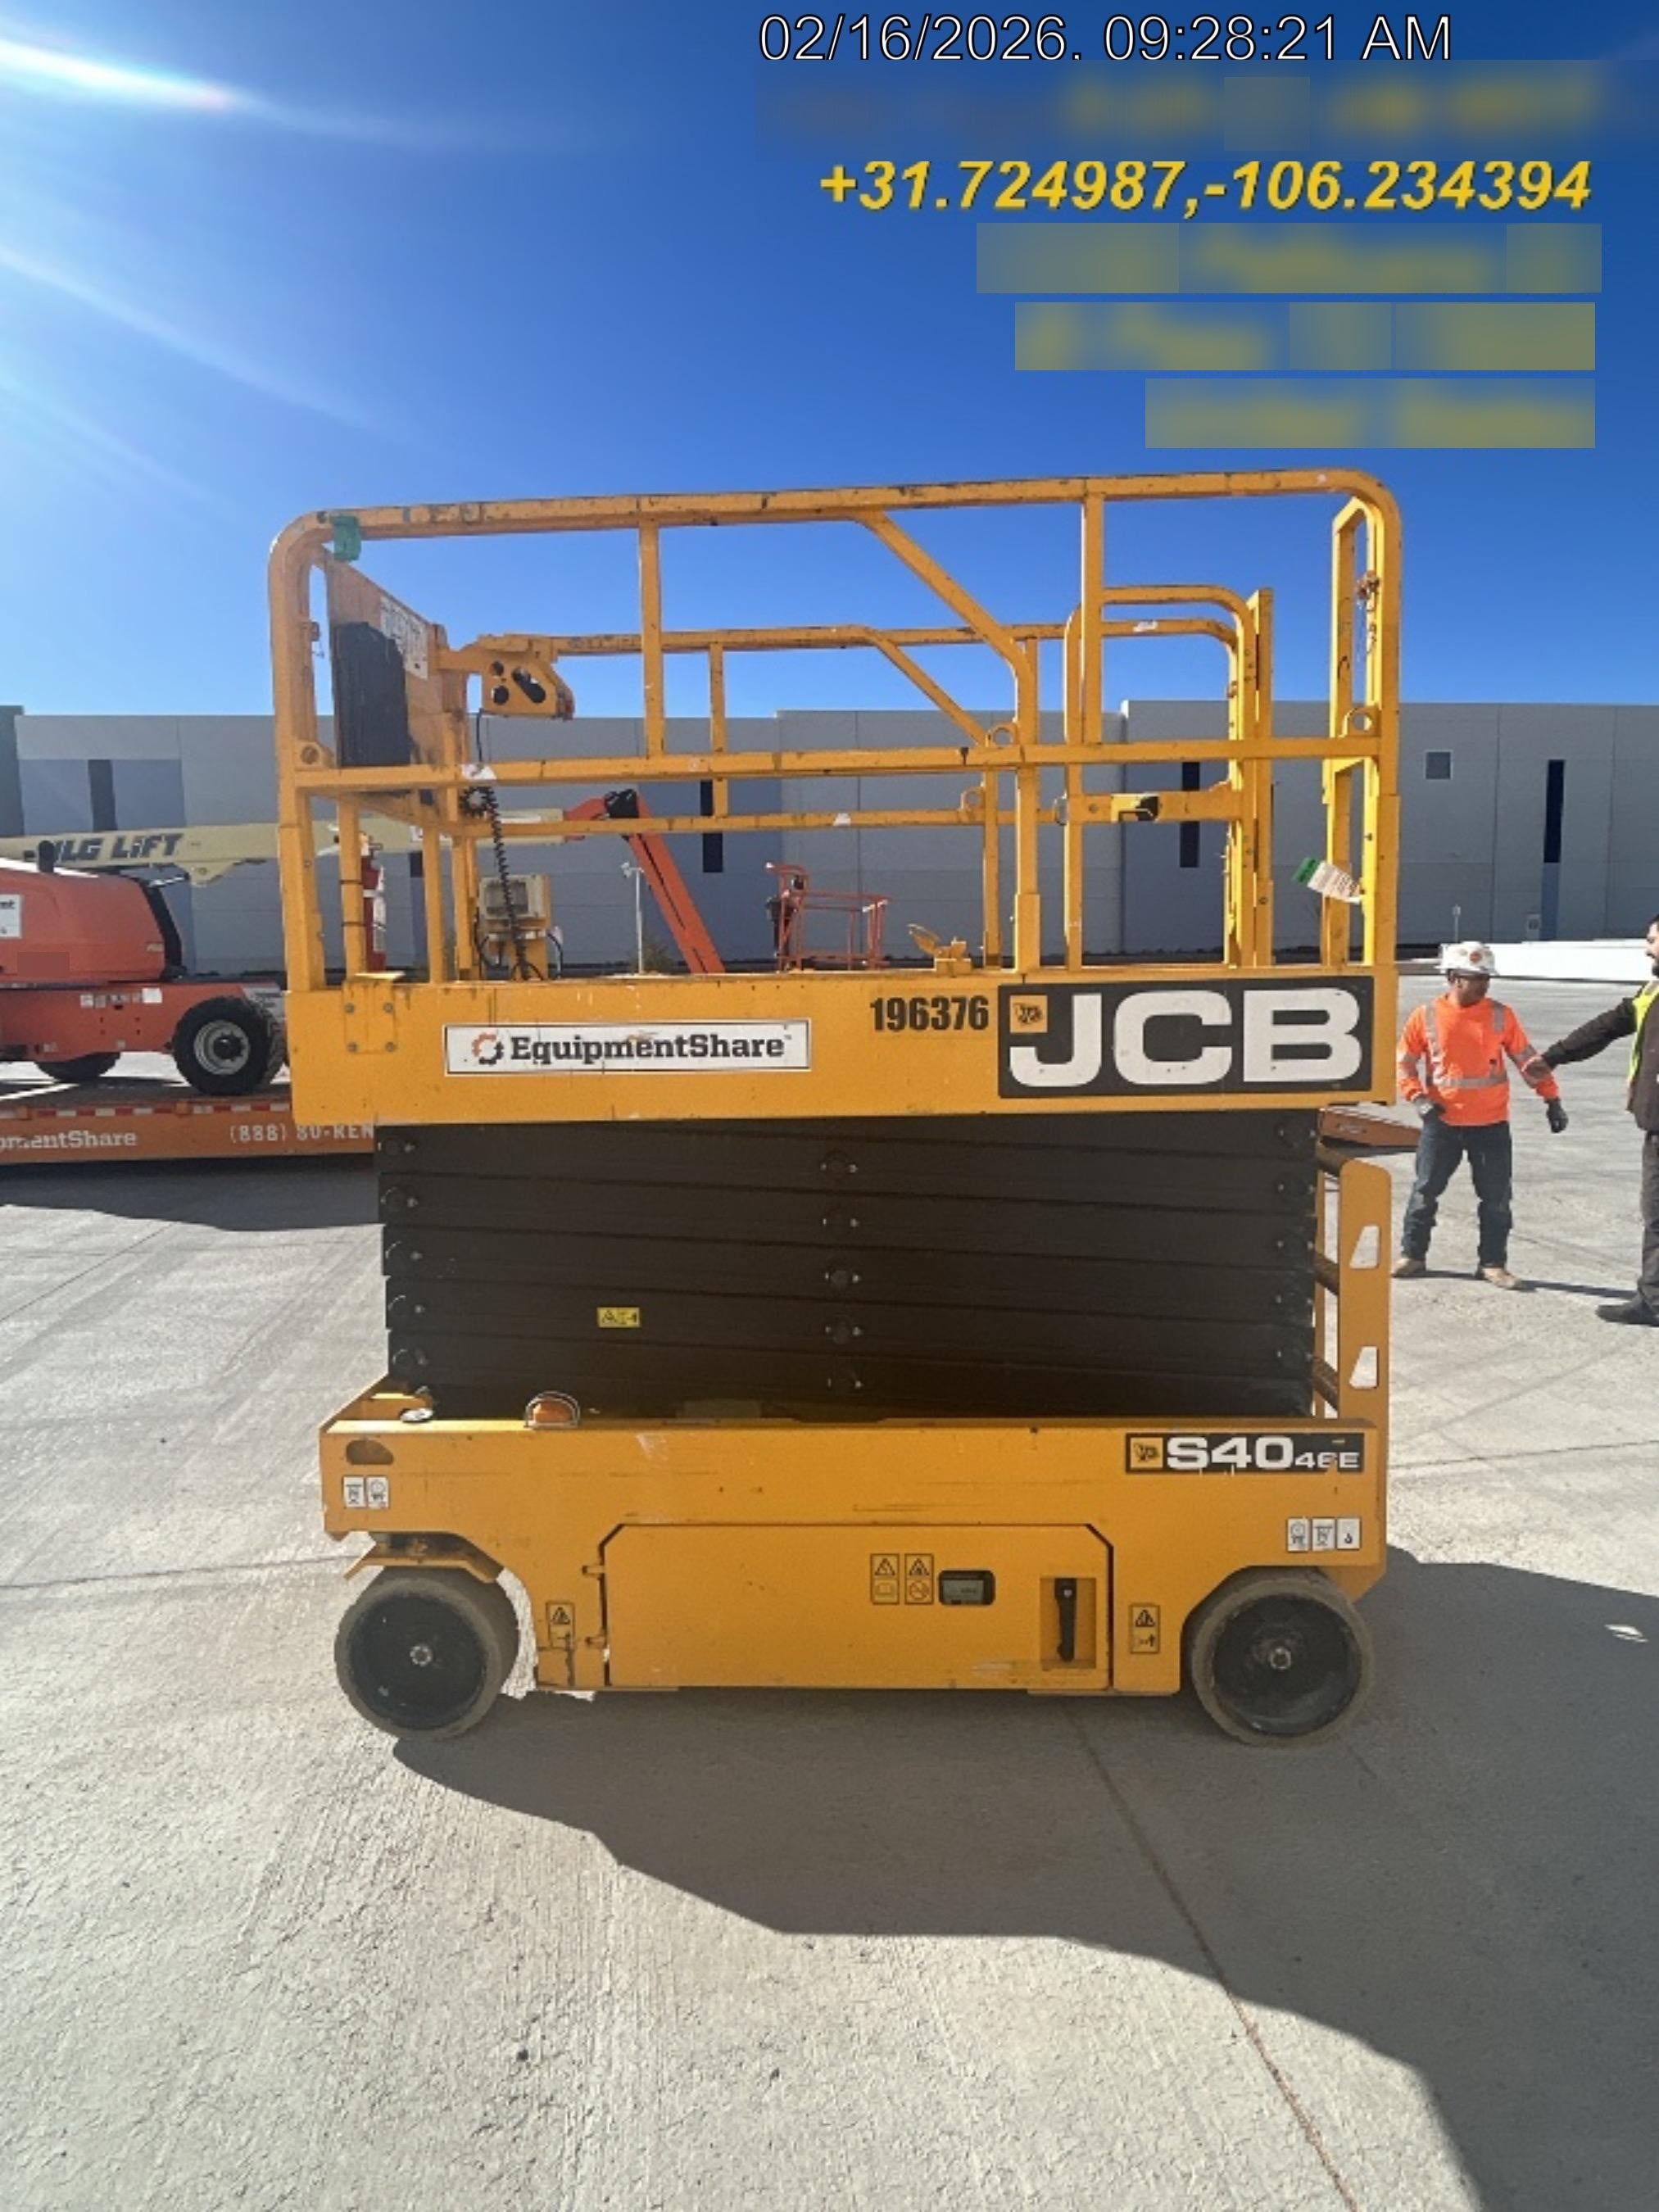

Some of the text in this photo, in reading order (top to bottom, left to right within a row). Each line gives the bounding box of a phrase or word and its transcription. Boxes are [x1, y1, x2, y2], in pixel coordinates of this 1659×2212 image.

[870, 995, 988, 1031] 196376
[510, 1035, 784, 1066] EquipmentShare
[1010, 988, 1362, 1088] JCB
